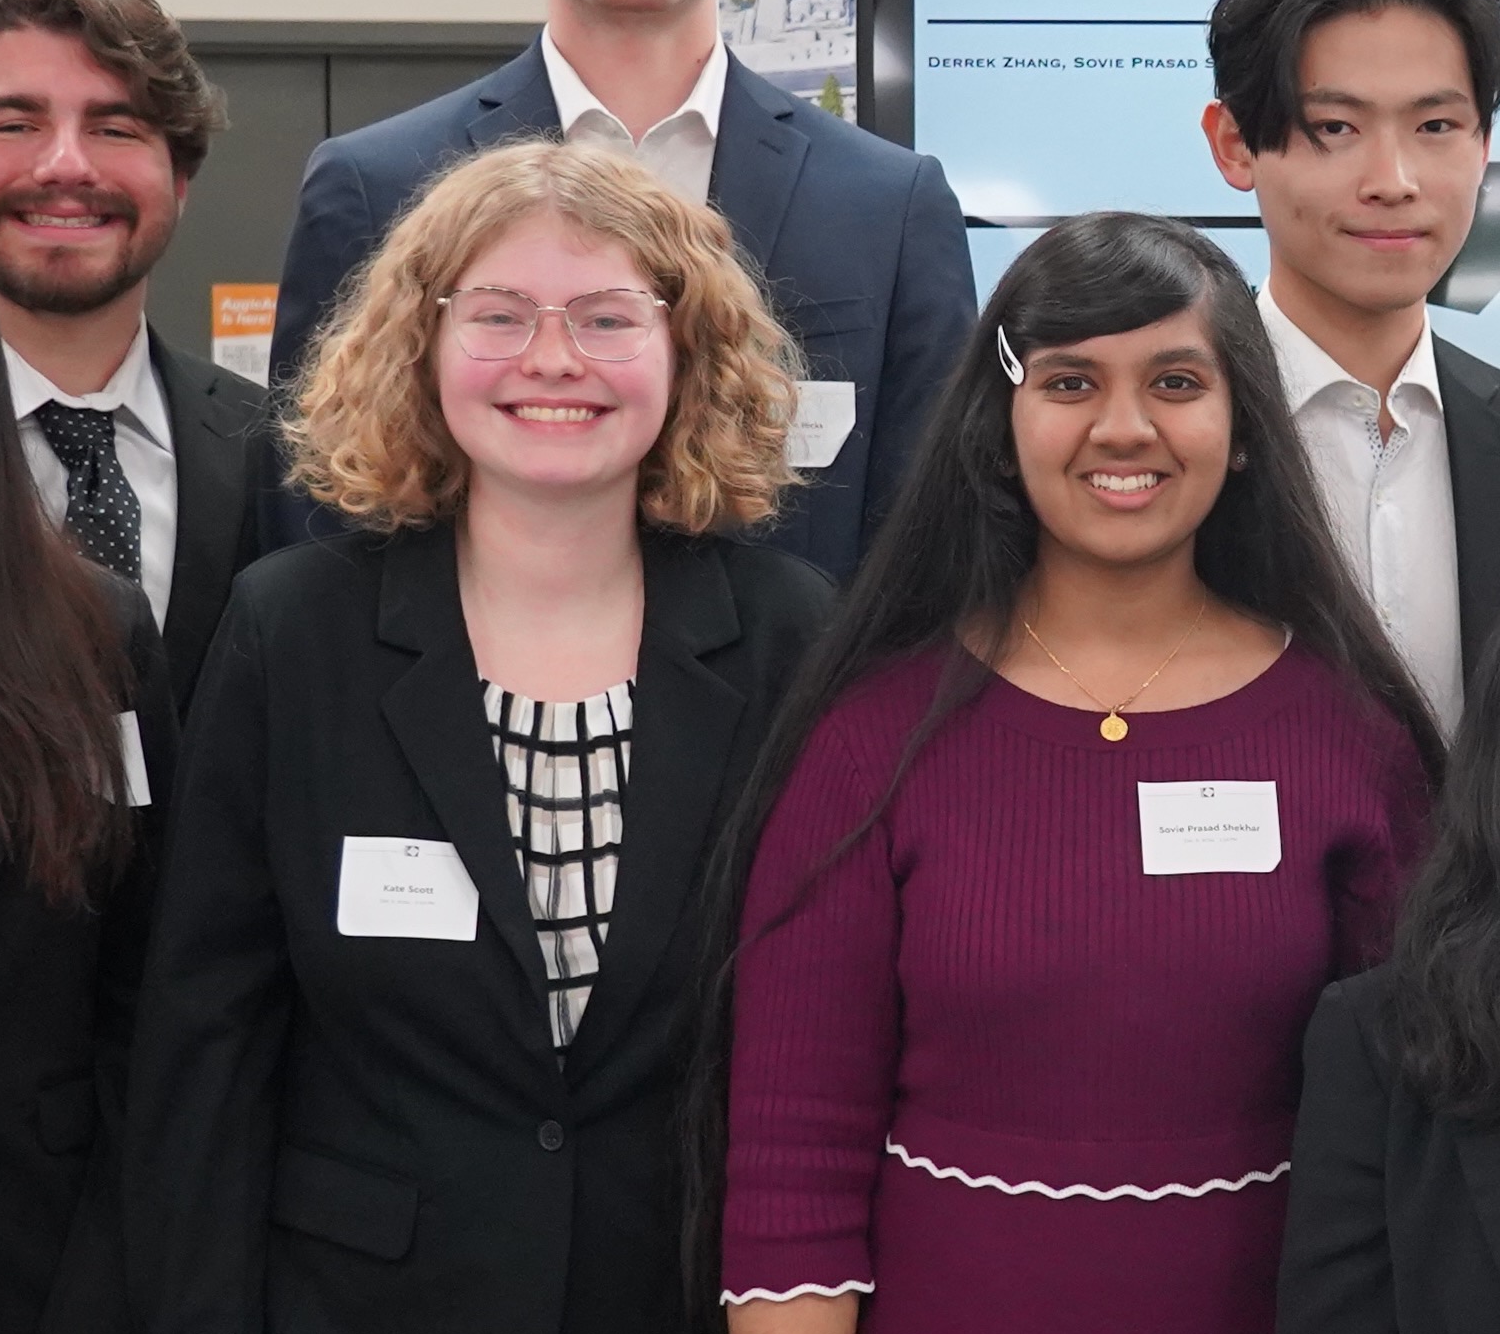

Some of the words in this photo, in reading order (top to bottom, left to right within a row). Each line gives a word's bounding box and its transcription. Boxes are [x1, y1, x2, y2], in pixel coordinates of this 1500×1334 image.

[928, 56, 996, 69] DERREK
[1074, 56, 1124, 69] SOVIE
[1132, 57, 1198, 69] PRASAD
[1159, 826, 1185, 834] Sovie
[1187, 824, 1220, 832] Prasad
[1222, 823, 1260, 832] Shekhar
[383, 884, 405, 893] Kate
[408, 885, 434, 895] Scott
